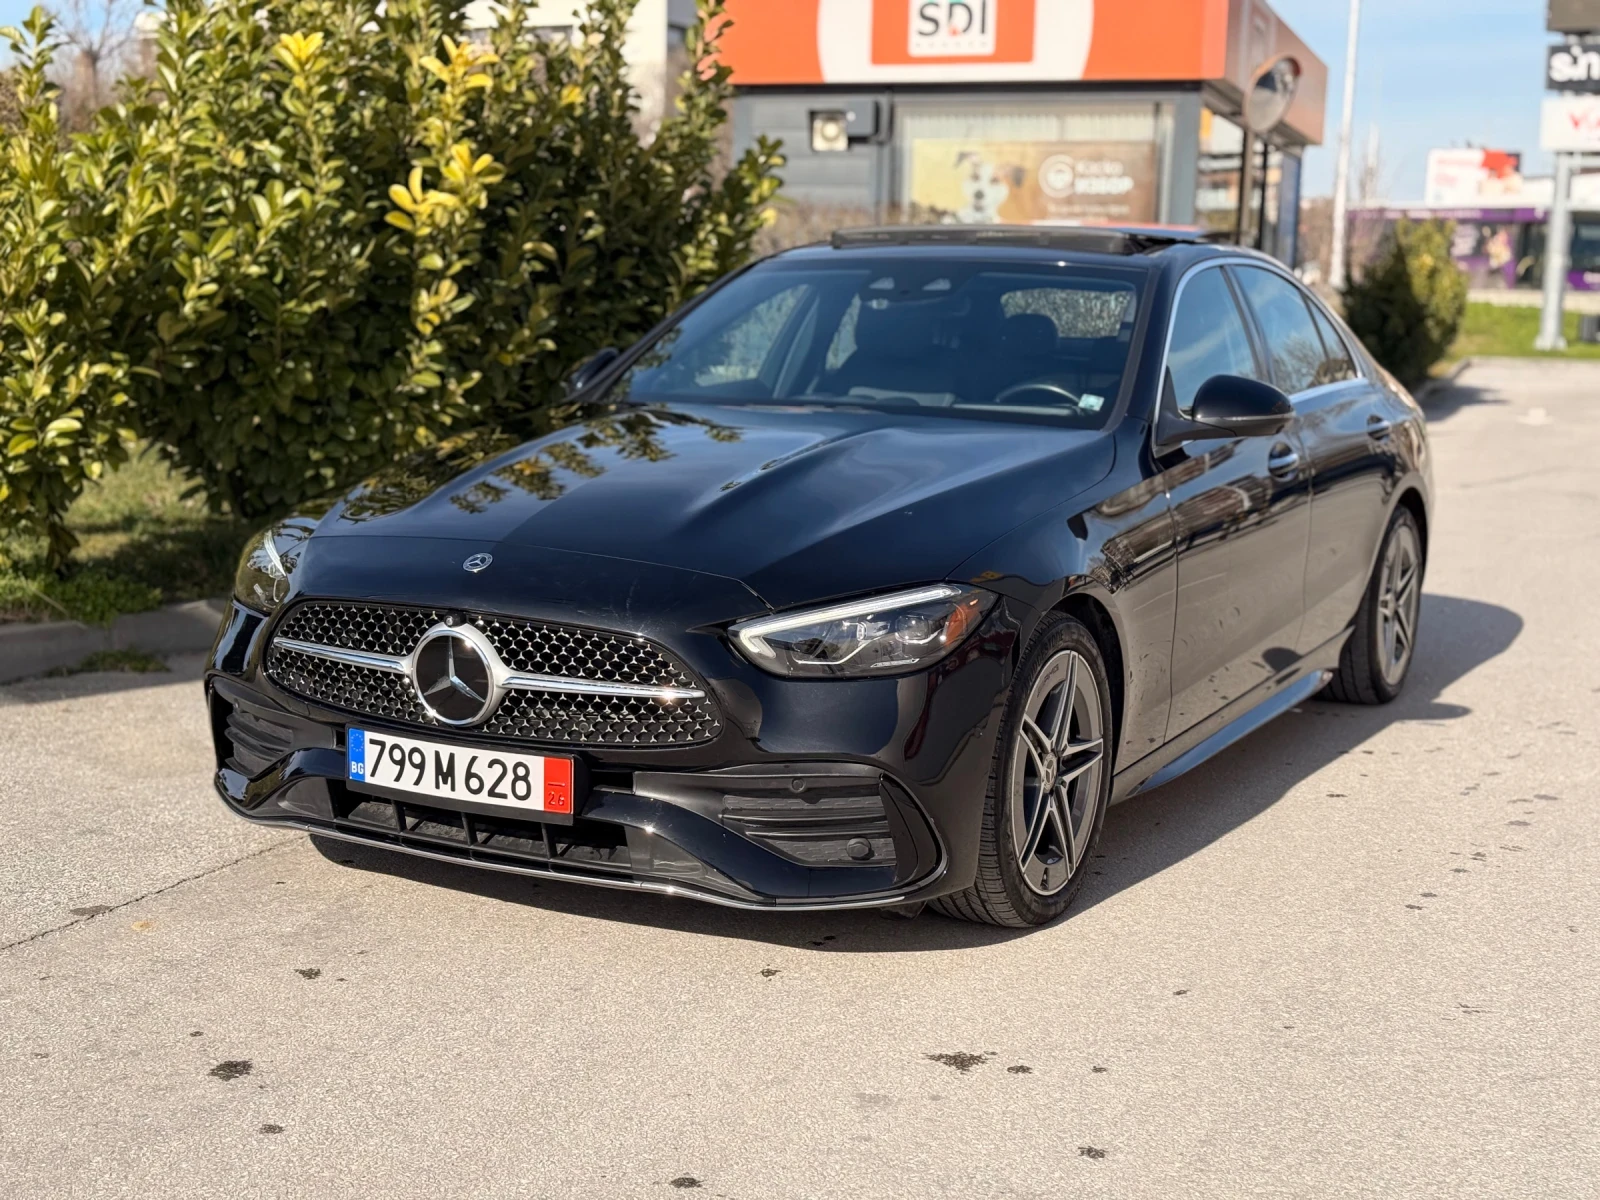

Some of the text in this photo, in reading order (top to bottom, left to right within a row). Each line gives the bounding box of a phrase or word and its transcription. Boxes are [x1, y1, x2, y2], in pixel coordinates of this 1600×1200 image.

[917, 0, 986, 36] SDI
[351, 761, 364, 774] BG
[548, 791, 565, 806] 26
